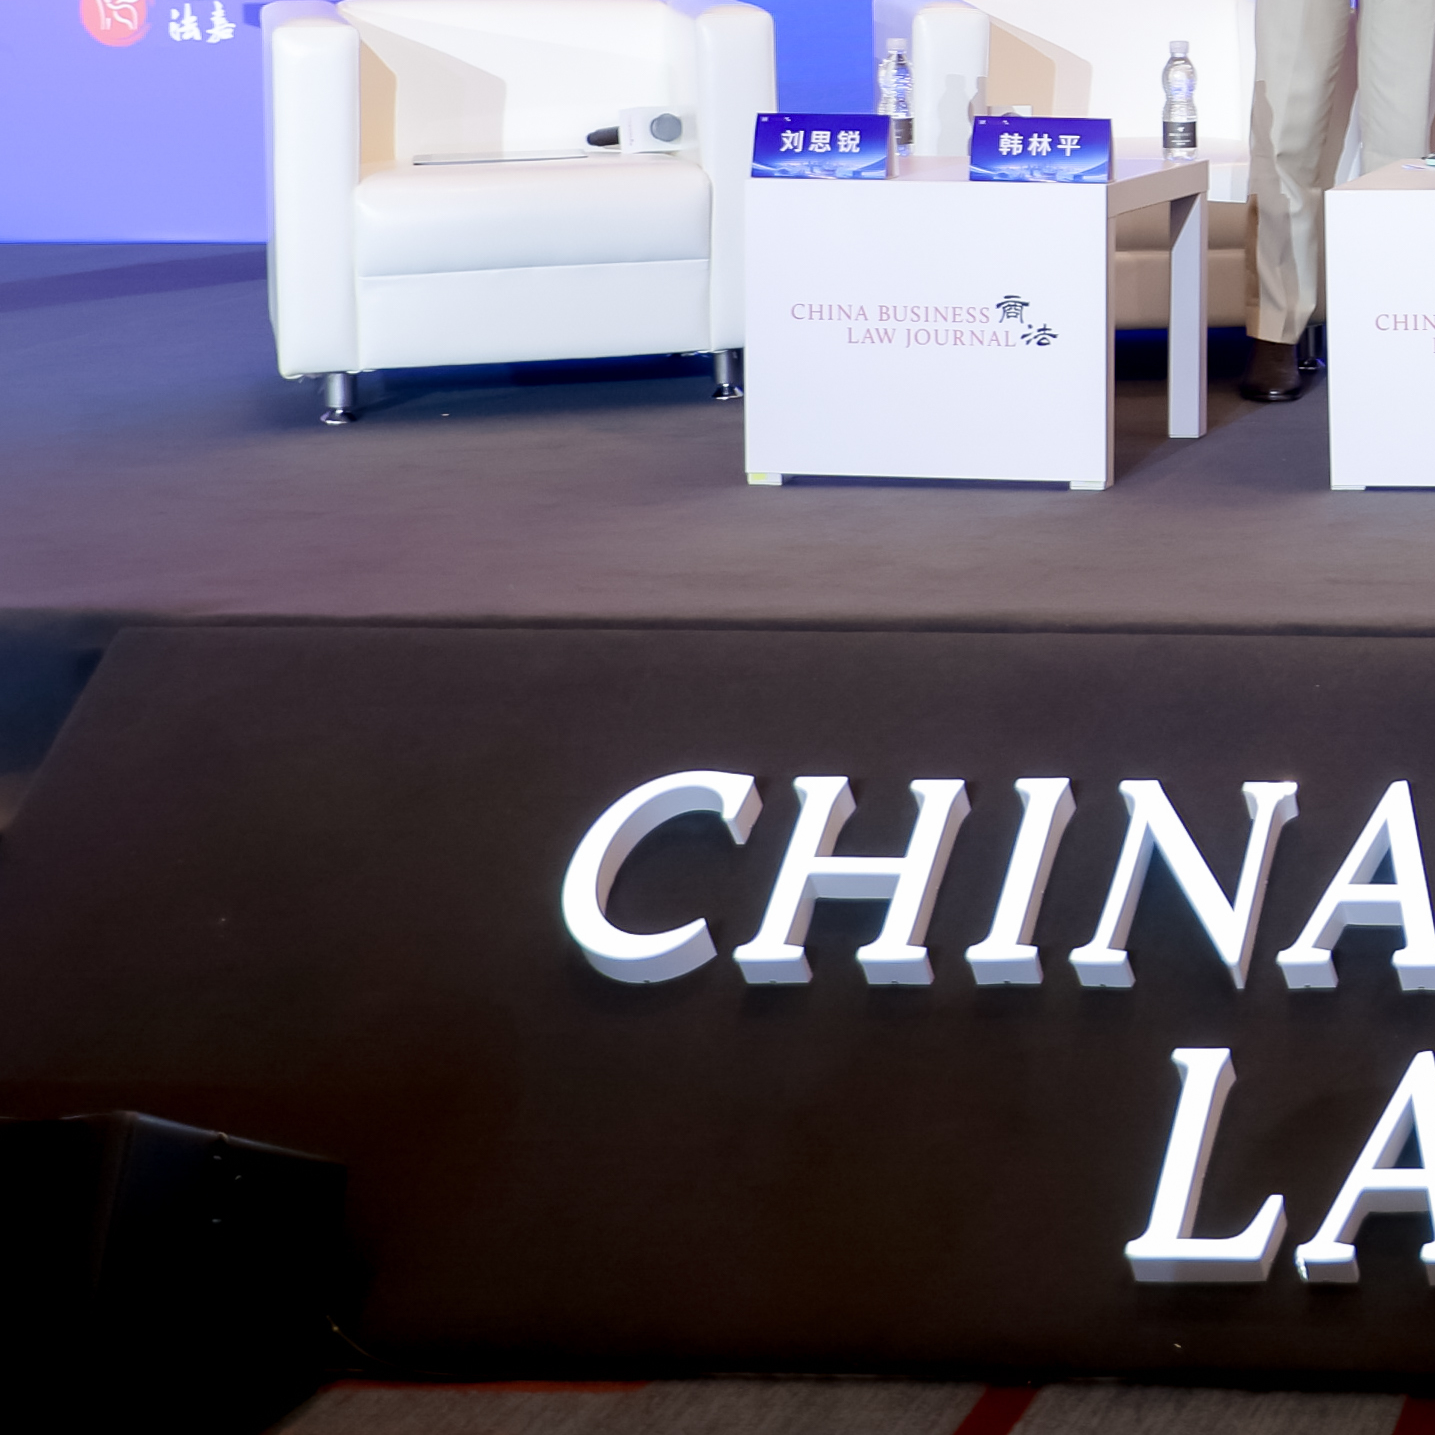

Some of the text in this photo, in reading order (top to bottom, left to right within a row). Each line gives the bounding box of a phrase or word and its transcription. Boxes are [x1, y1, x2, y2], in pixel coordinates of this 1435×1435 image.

[780, 129, 861, 153] 刘思锐
[998, 133, 1081, 157] 韩林平
[791, 303, 990, 324] CHINA BUSINESS
[847, 326, 1017, 348] LAW JOURNAL
